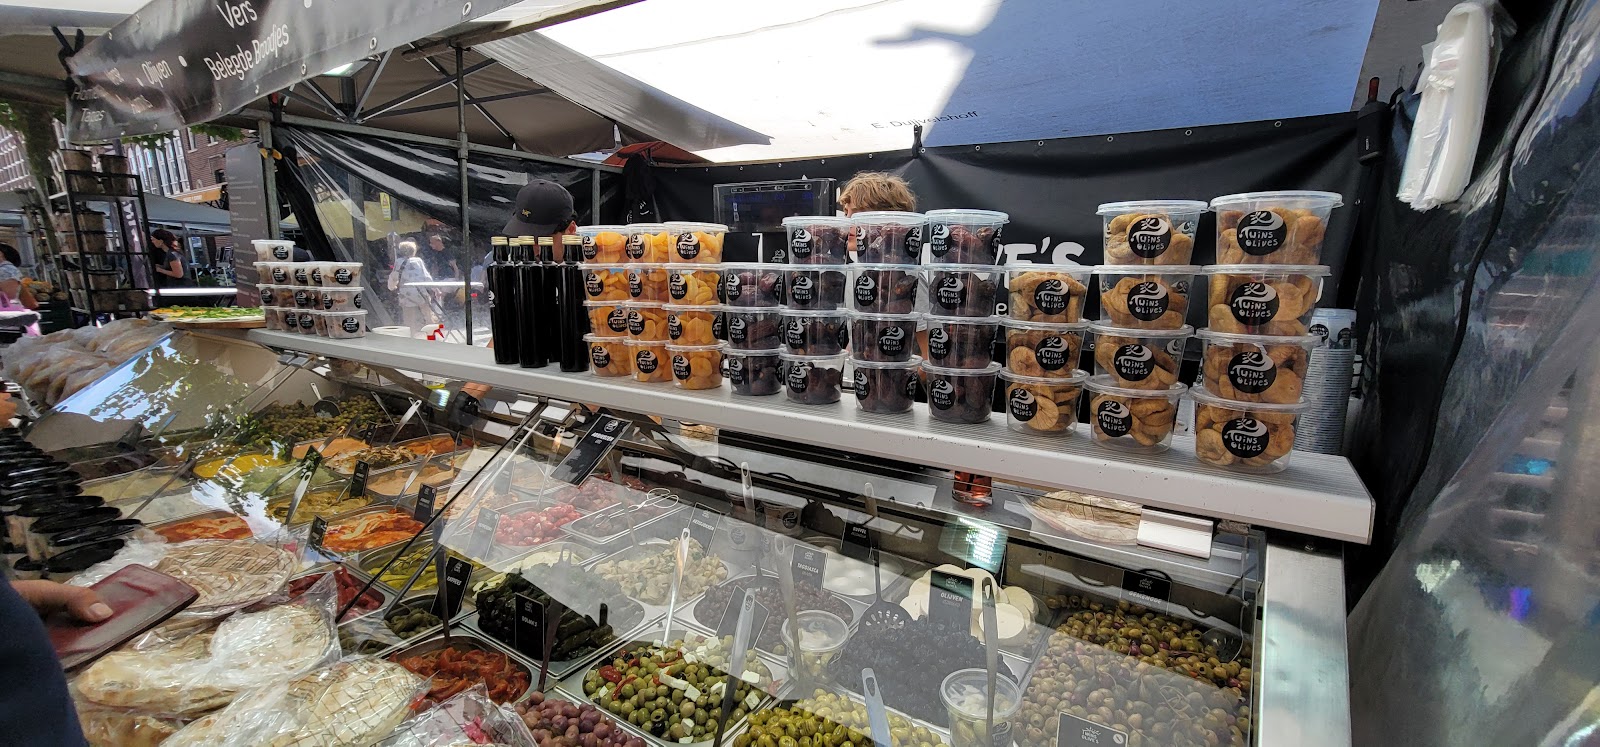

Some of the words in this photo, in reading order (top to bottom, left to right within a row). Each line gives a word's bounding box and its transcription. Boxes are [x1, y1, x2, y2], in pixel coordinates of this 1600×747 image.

[217, 0, 258, 29] Vers
[203, 44, 253, 81] Belegde
[940, 592, 964, 602] OLIJVEN
